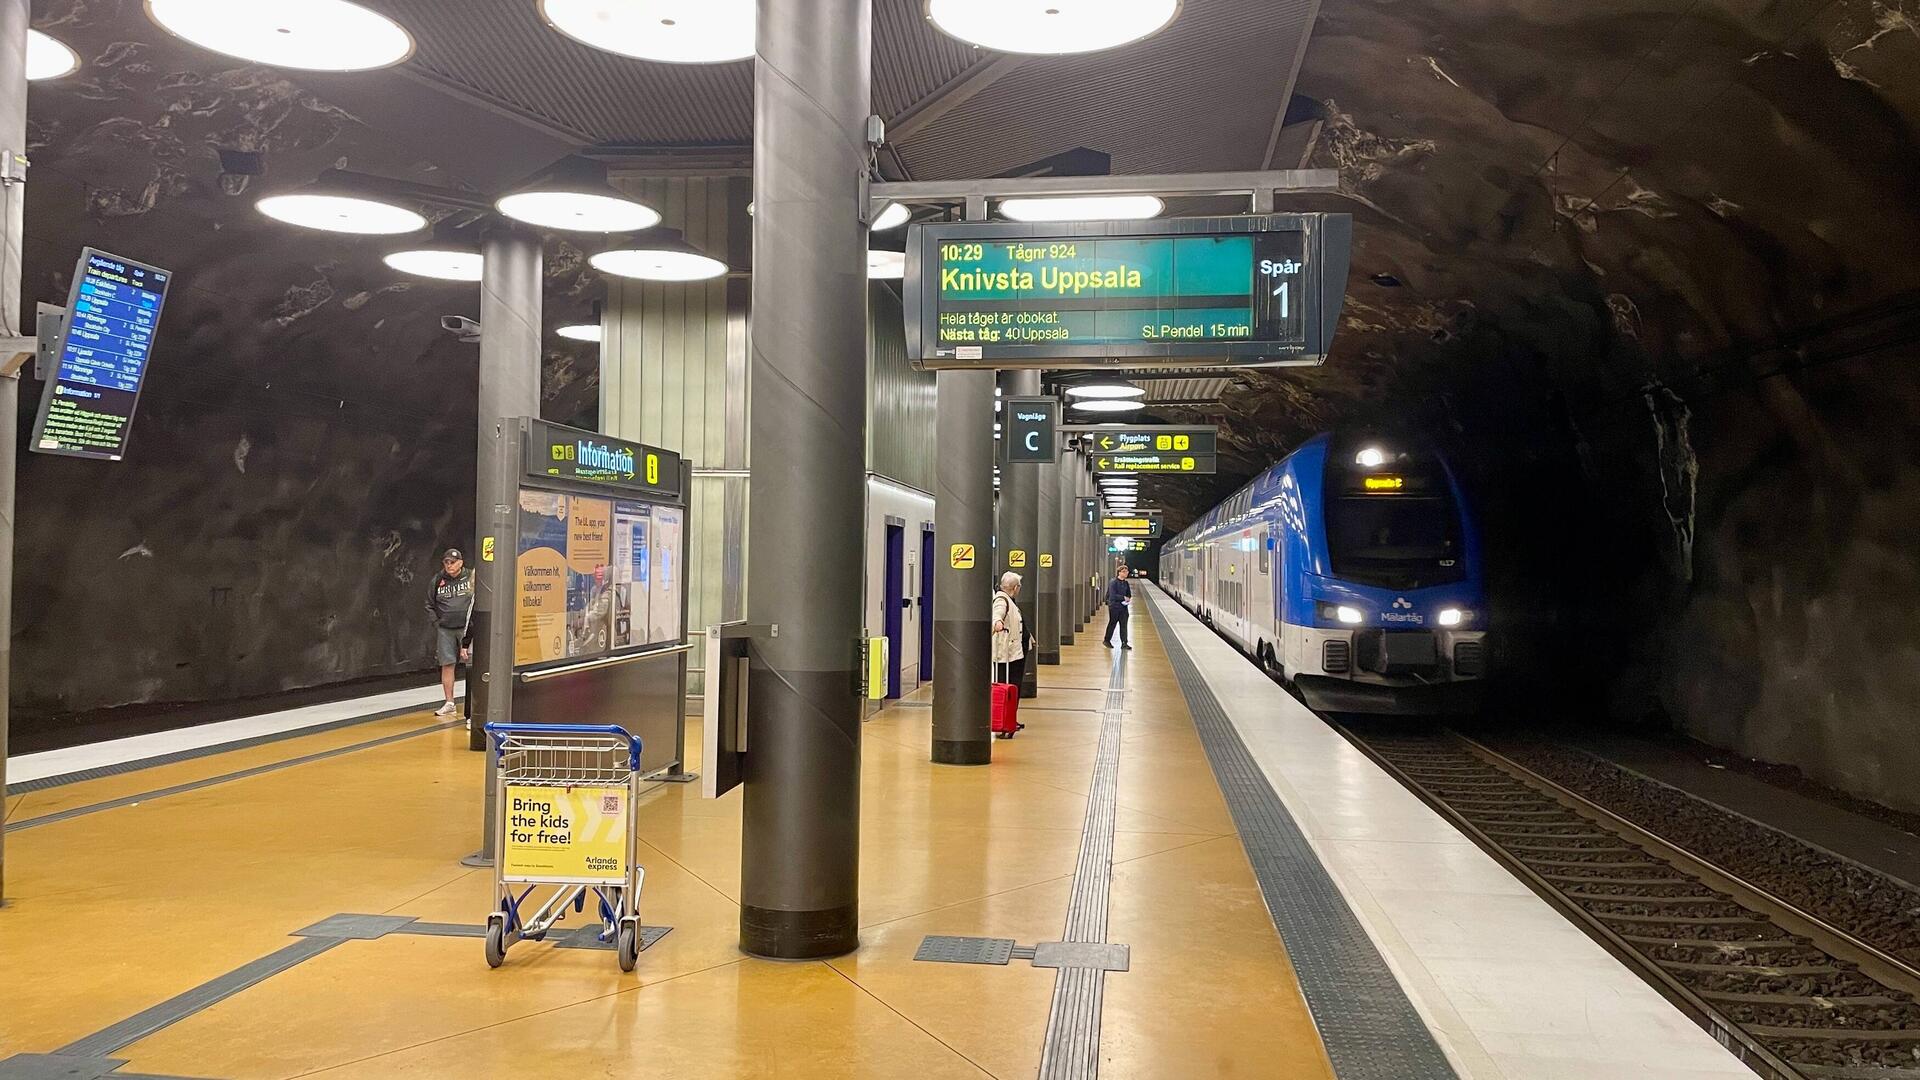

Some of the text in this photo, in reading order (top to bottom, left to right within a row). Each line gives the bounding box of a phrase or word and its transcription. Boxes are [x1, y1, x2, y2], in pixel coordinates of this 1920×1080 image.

[940, 243, 1076, 262] 10:29 Tågnr 924
[1260, 259, 1301, 278] Spår
[941, 267, 1141, 293] Knivsta Uppsala
[1272, 281, 1288, 318] 1
[940, 311, 1060, 327] Hela tåget är obokat.
[940, 327, 1069, 343] Nästa tåg: 40 Uppsala
[1142, 324, 1249, 338] SL Pendel 15 min
[1017, 412, 1046, 421] Vagnläge
[1025, 431, 1039, 451] C
[578, 440, 633, 475] Information
[1381, 612, 1423, 624] Mälartåg
[513, 798, 551, 815] Bring
[511, 814, 569, 828] the kids
[510, 829, 571, 844] for free!
[585, 856, 618, 865] Arlanda
[587, 864, 618, 872] express
